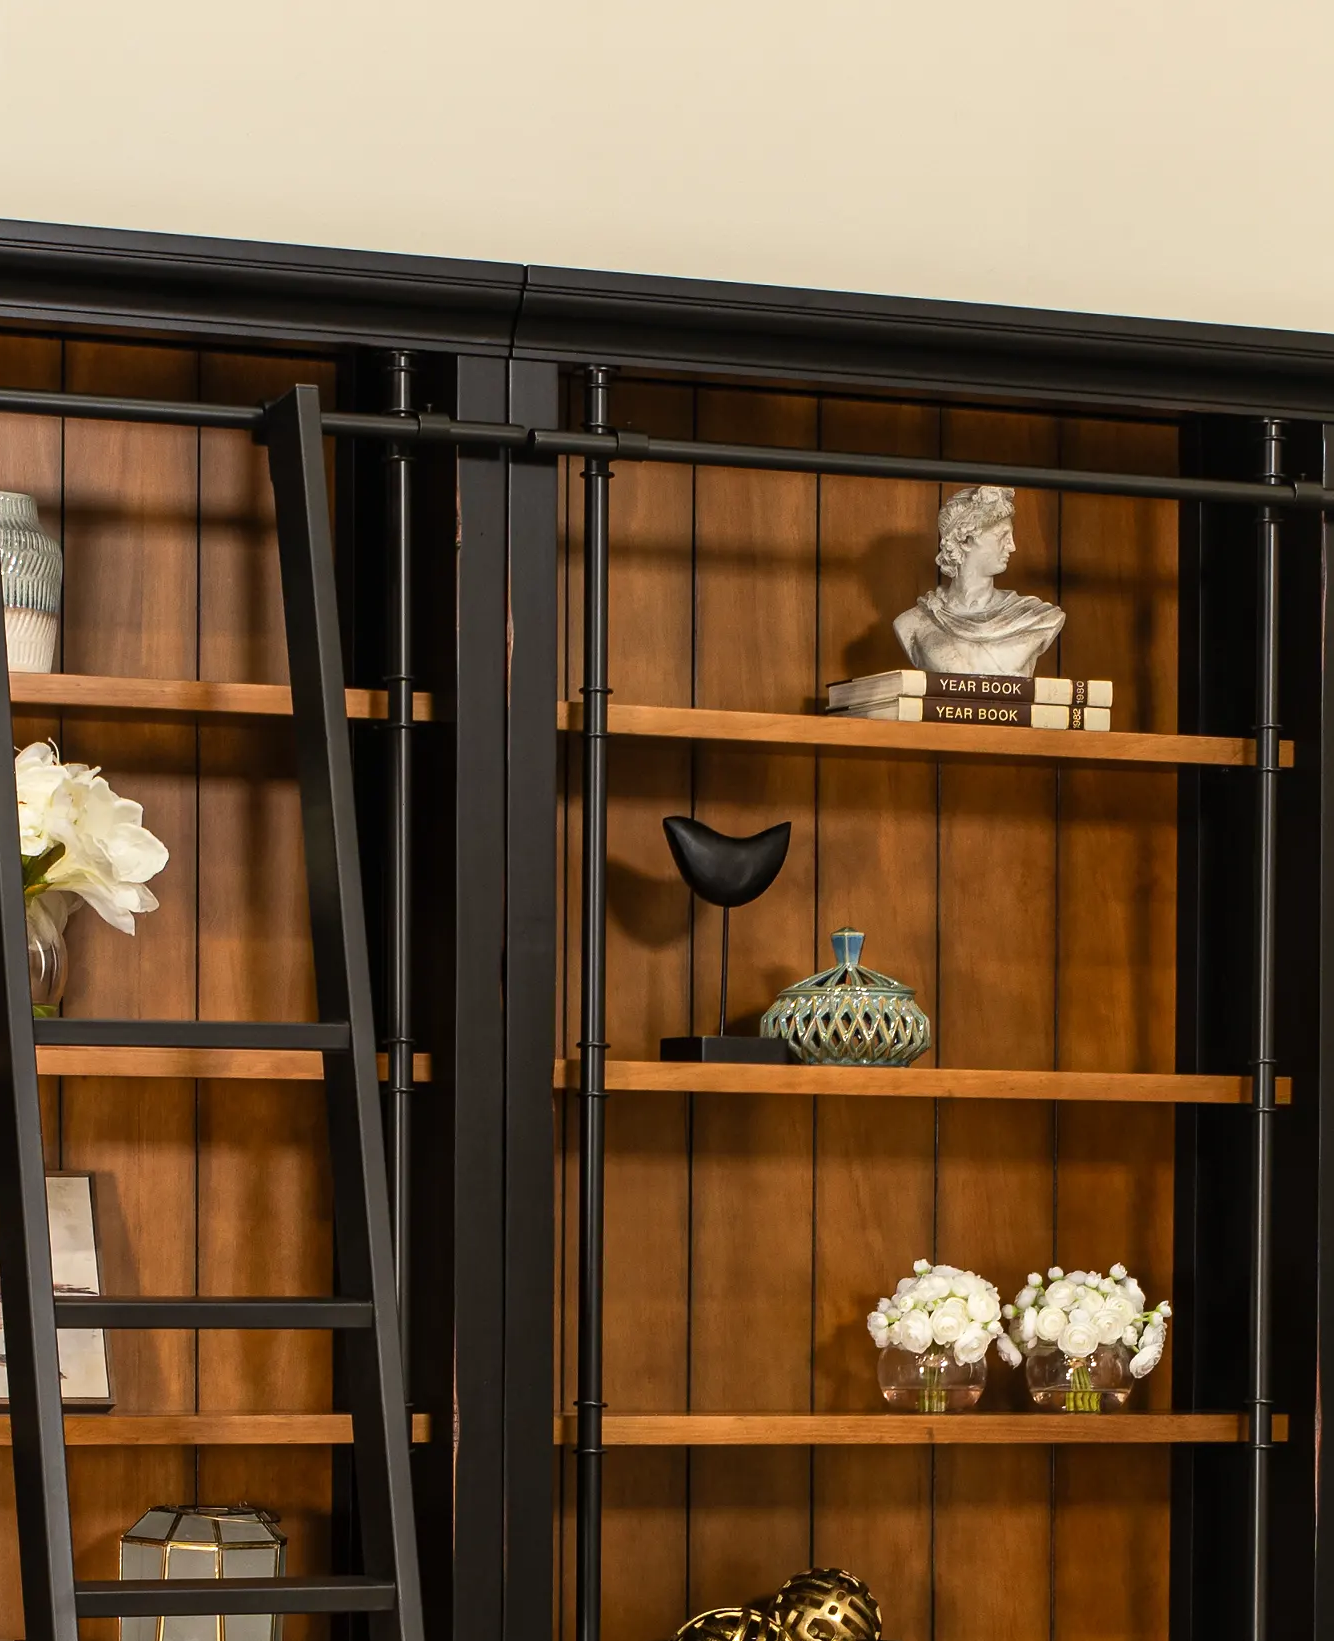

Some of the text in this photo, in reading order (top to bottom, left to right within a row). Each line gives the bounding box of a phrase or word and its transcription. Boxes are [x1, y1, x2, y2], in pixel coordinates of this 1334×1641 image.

[939, 678, 1022, 695] YEAR BOOK
[936, 706, 1018, 722] YEAR BOOK
[1072, 708, 1082, 729] 1982
